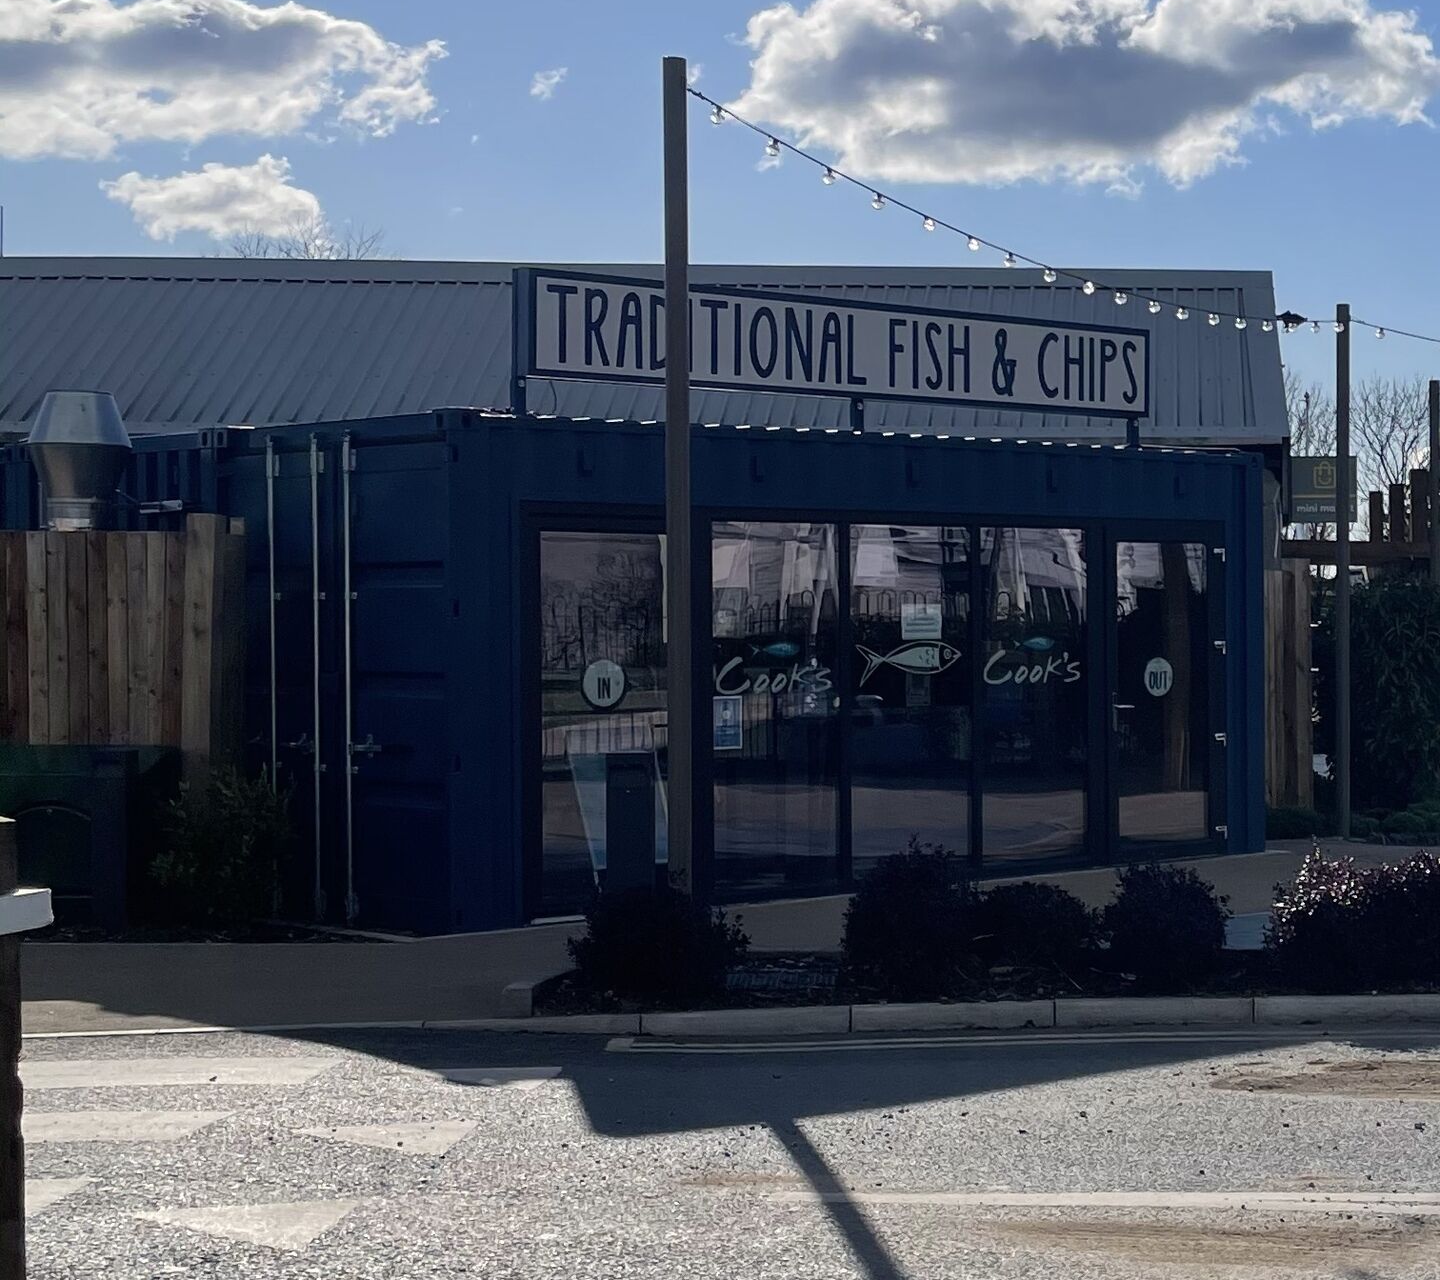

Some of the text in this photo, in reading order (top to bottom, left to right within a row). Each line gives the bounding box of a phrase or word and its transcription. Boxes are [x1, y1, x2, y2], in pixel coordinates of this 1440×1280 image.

[547, 284, 1138, 405] TRADITIONAL FISH & CHIPS
[1296, 503, 1355, 513] mini mat
[715, 656, 833, 695] Cook's
[983, 649, 1081, 685] Cook's
[1149, 670, 1168, 690] OUT
[597, 677, 611, 699] IN
